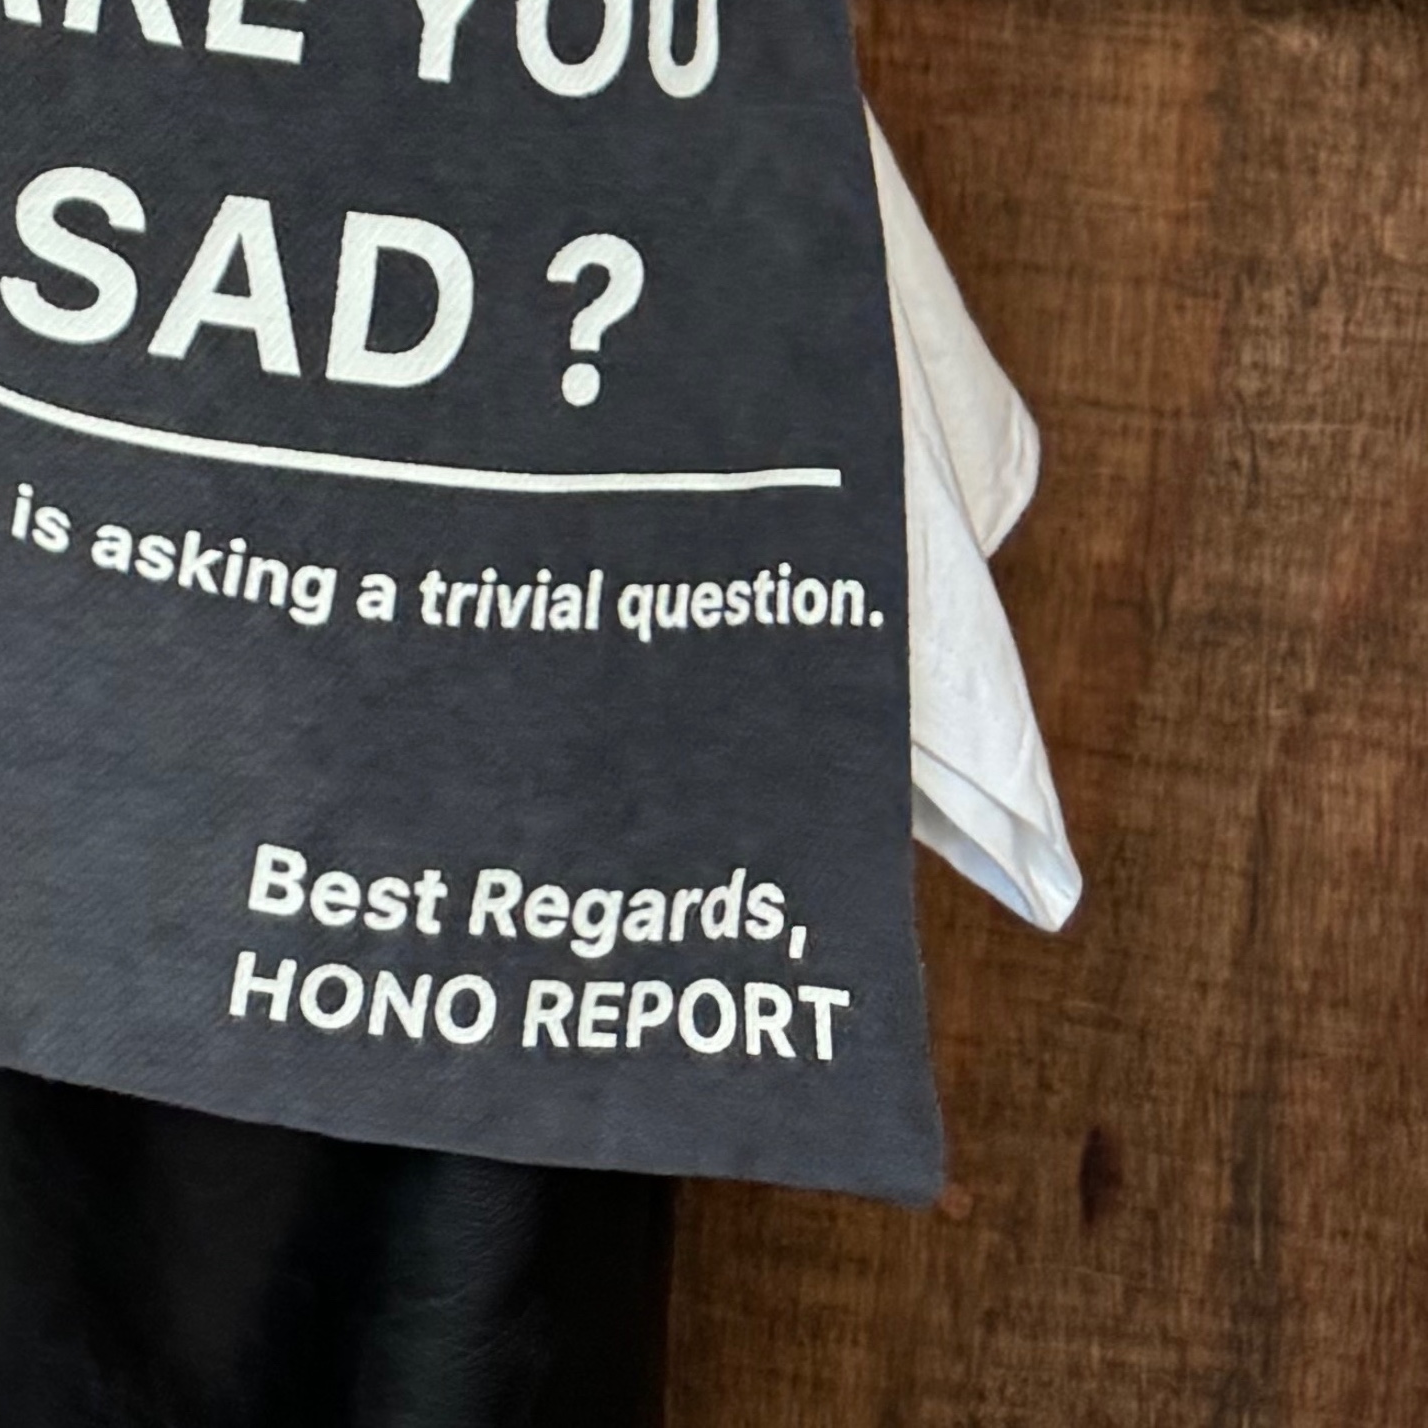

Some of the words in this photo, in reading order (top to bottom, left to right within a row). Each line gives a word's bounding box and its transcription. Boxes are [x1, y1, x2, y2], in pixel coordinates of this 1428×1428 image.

[0, 167, 473, 387] SAD
[547, 234, 644, 406] ?
[12, 483, 70, 552] is
[91, 525, 337, 625] asking
[356, 574, 396, 621] a
[420, 568, 603, 630] trivial
[618, 570, 883, 642] question.
[248, 844, 447, 934] Best
[469, 868, 806, 958] Regards,
[229, 951, 496, 1044] HONO
[522, 979, 849, 1060] REPORT
